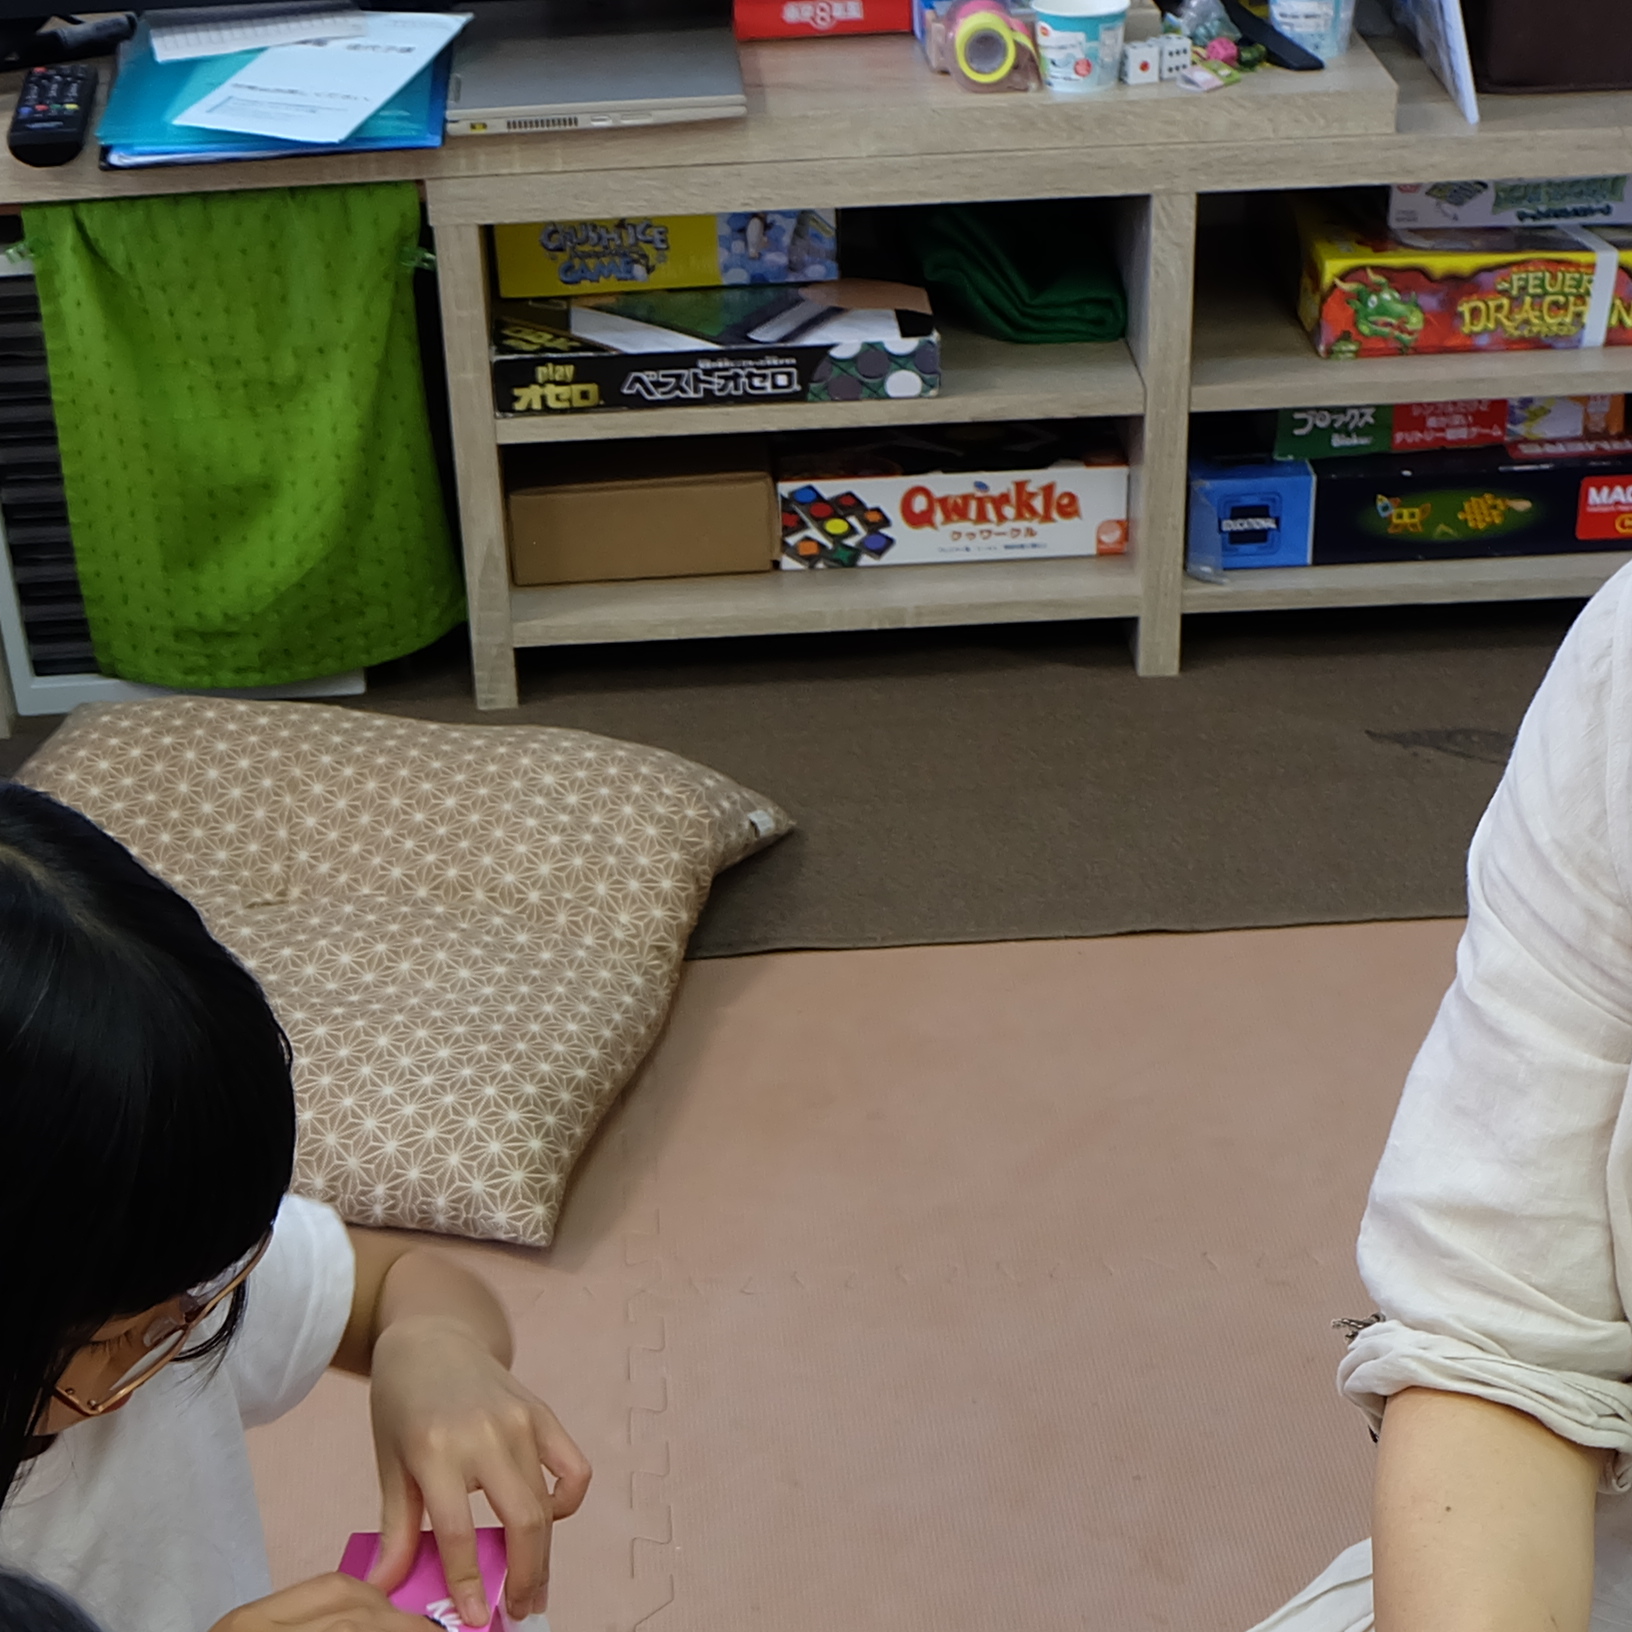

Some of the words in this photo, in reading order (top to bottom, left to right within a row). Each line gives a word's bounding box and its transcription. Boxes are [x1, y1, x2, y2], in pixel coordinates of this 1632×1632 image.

[540, 220, 621, 252] CRUSH
[625, 217, 671, 251] ICE
[557, 257, 637, 286] GAME
[534, 361, 576, 386] play
[620, 367, 800, 402] ベストオセロ
[511, 382, 599, 412] オセロ
[899, 478, 1083, 531] Qwirkle
